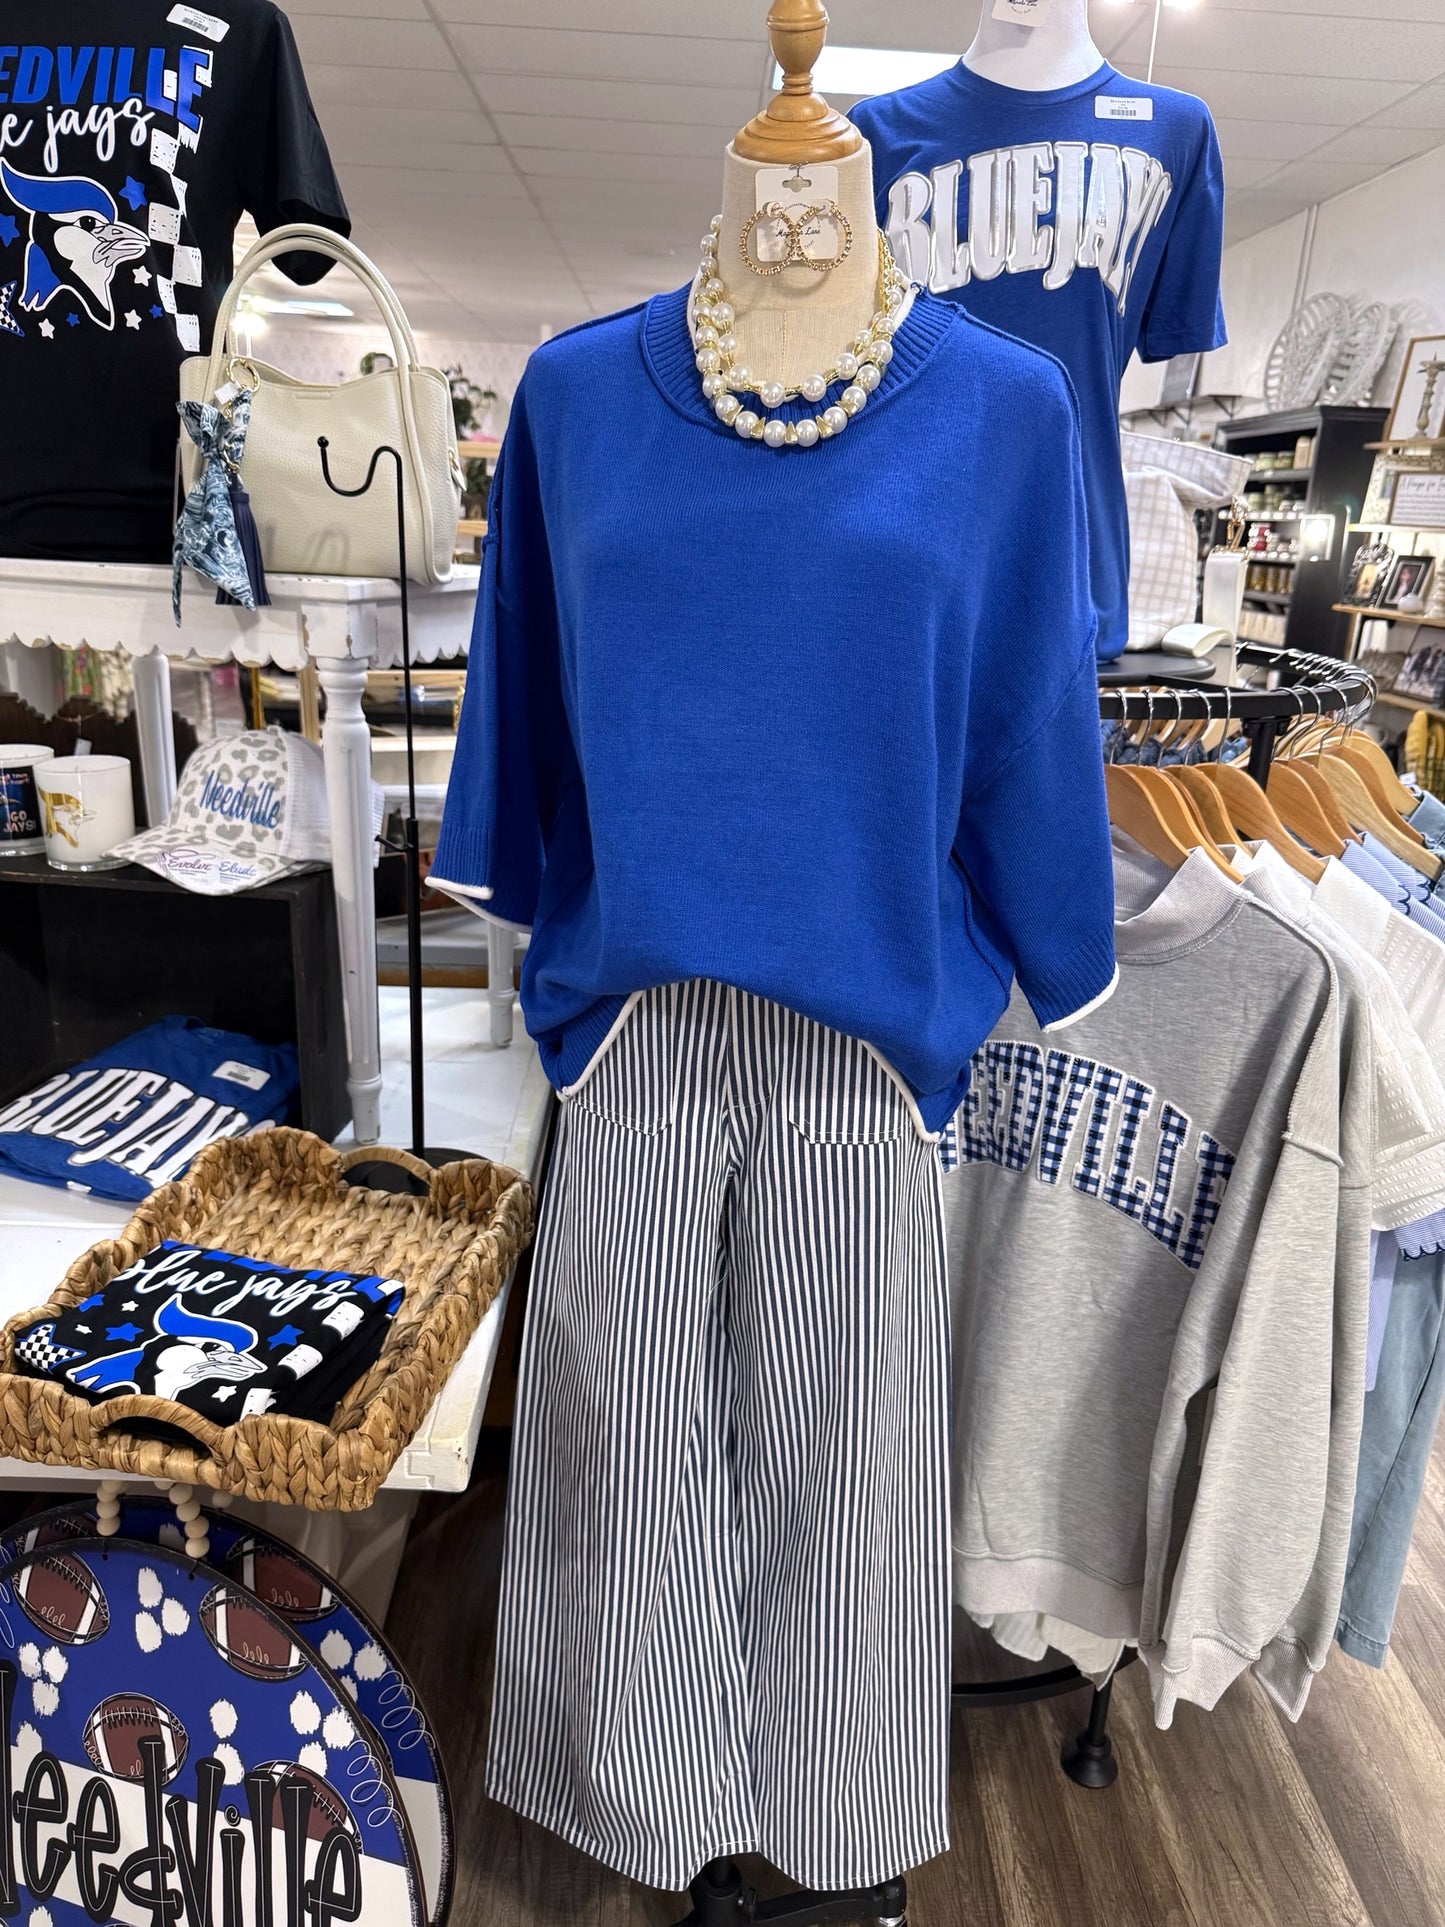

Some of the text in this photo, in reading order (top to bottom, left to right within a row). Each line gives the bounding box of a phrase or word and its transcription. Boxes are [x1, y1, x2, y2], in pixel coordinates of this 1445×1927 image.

[43, 98, 155, 173] jays
[886, 141, 1172, 317] BLUEJAY
[10, 810, 27, 822] GO
[199, 769, 280, 829] Needville
[0, 1068, 276, 1190] BLUEJAY
[211, 1272, 357, 1317] jays
